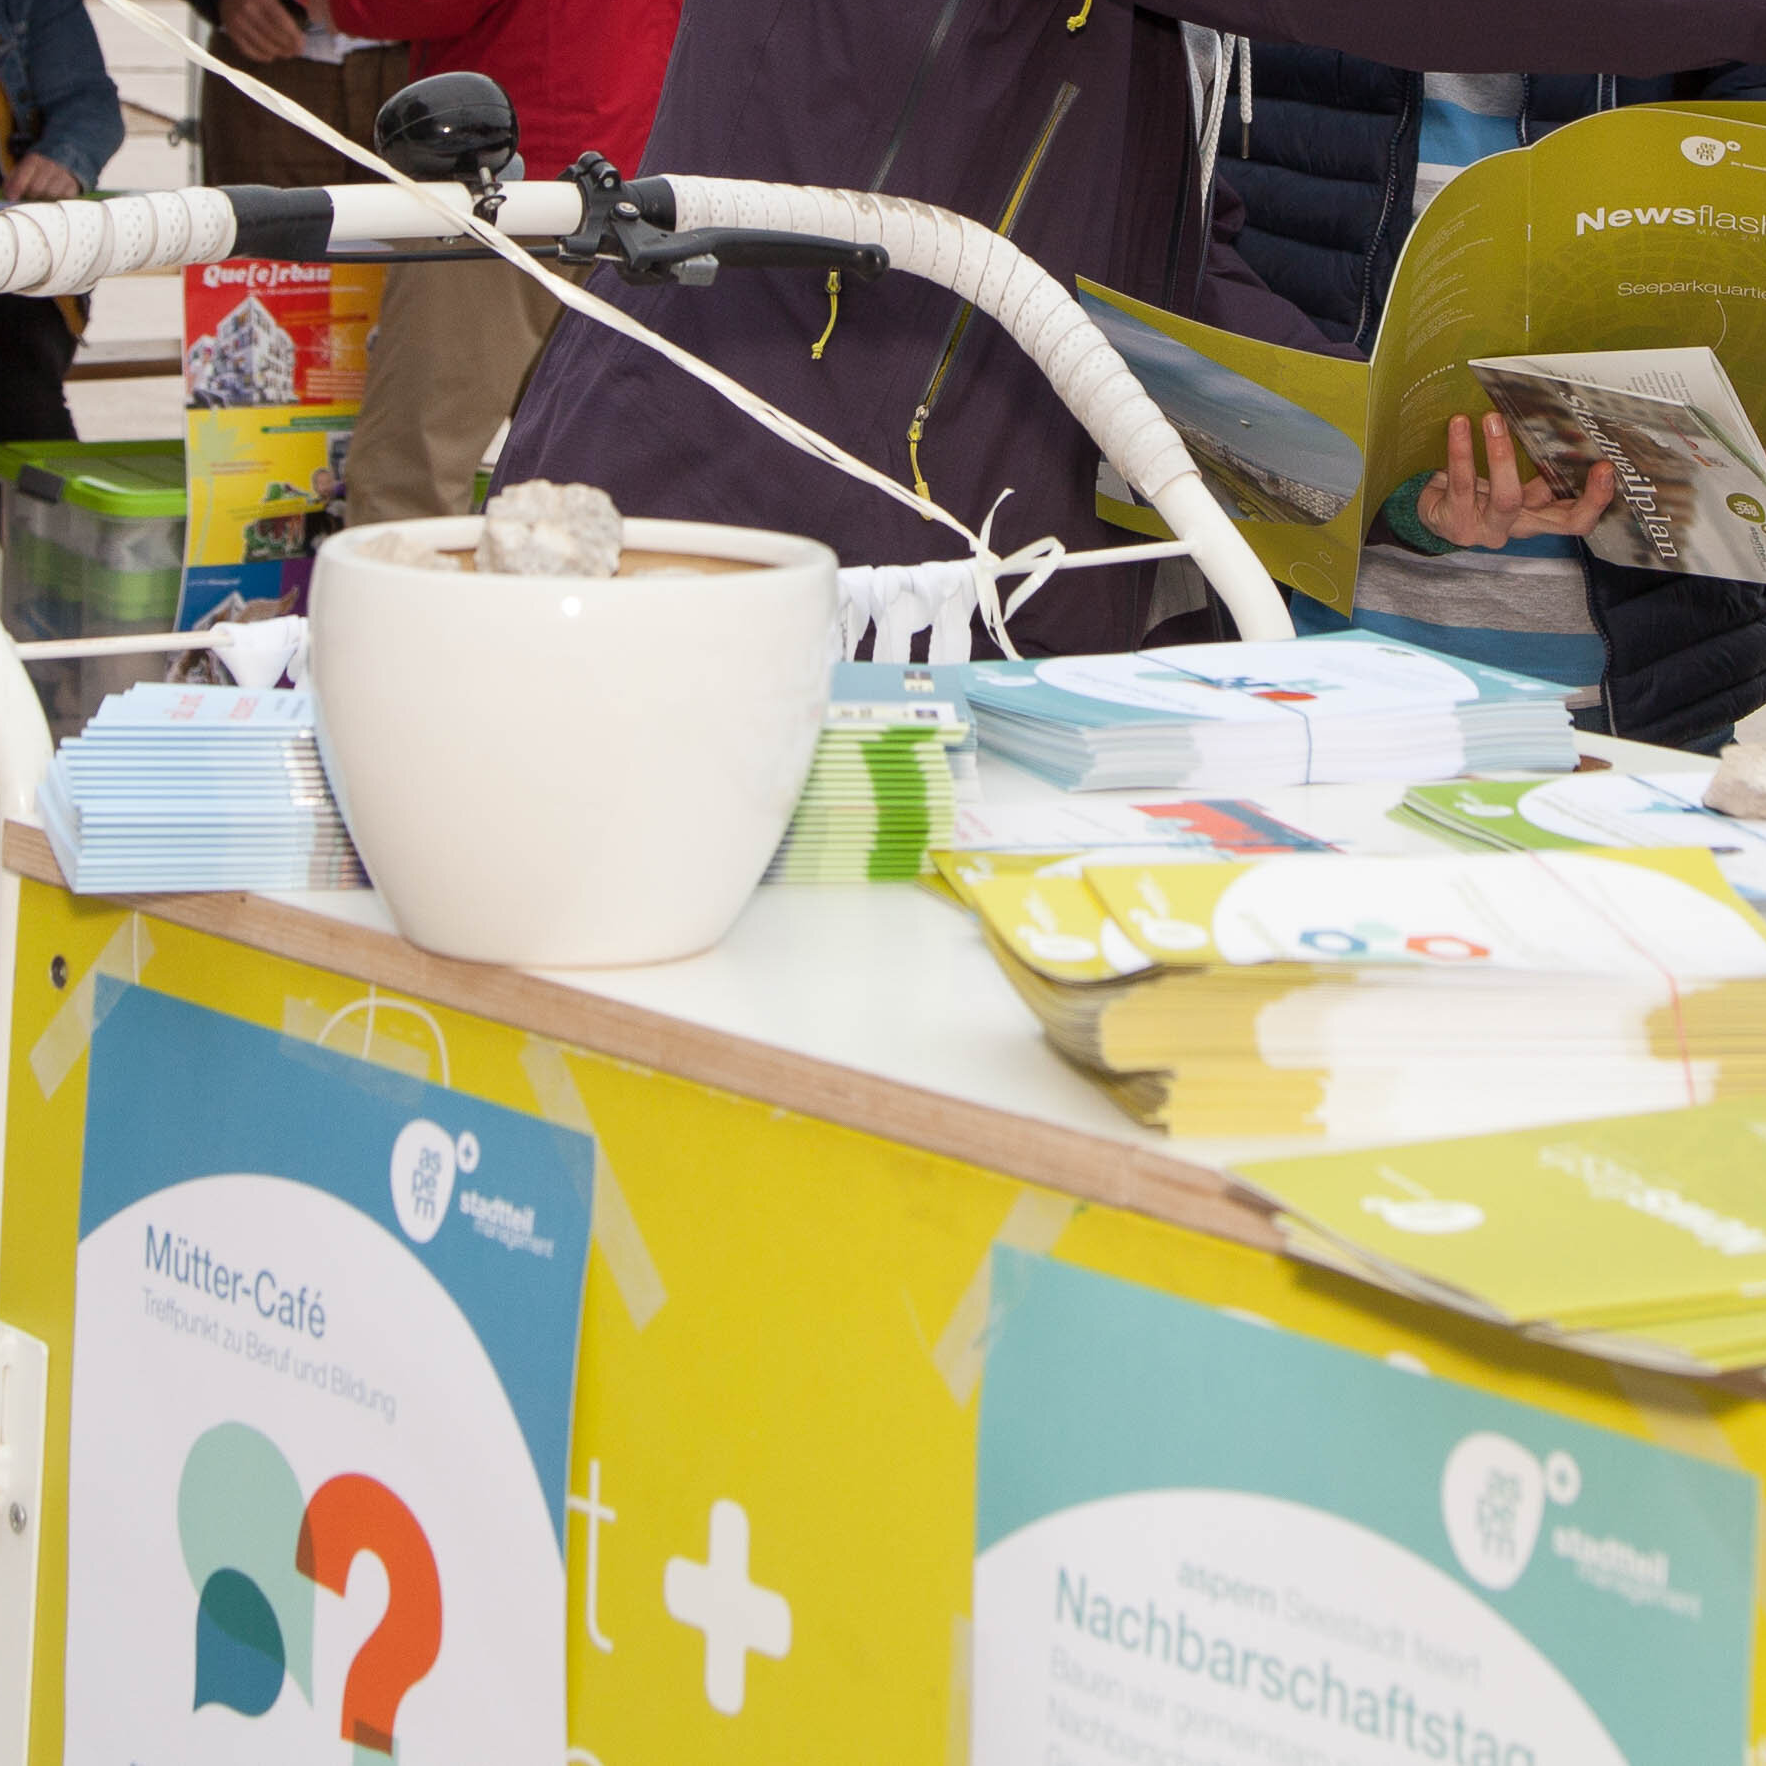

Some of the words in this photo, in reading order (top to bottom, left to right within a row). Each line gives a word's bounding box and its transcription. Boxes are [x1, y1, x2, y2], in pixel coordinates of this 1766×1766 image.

[1559, 390, 1679, 561] Stadtteilplan
[145, 1223, 326, 1339] Mütter-Café
[142, 1285, 220, 1347] Treffpunkt
[222, 1327, 243, 1355] zu
[245, 1330, 291, 1373] Beruf
[293, 1355, 327, 1389] und
[331, 1364, 397, 1425] Bildung
